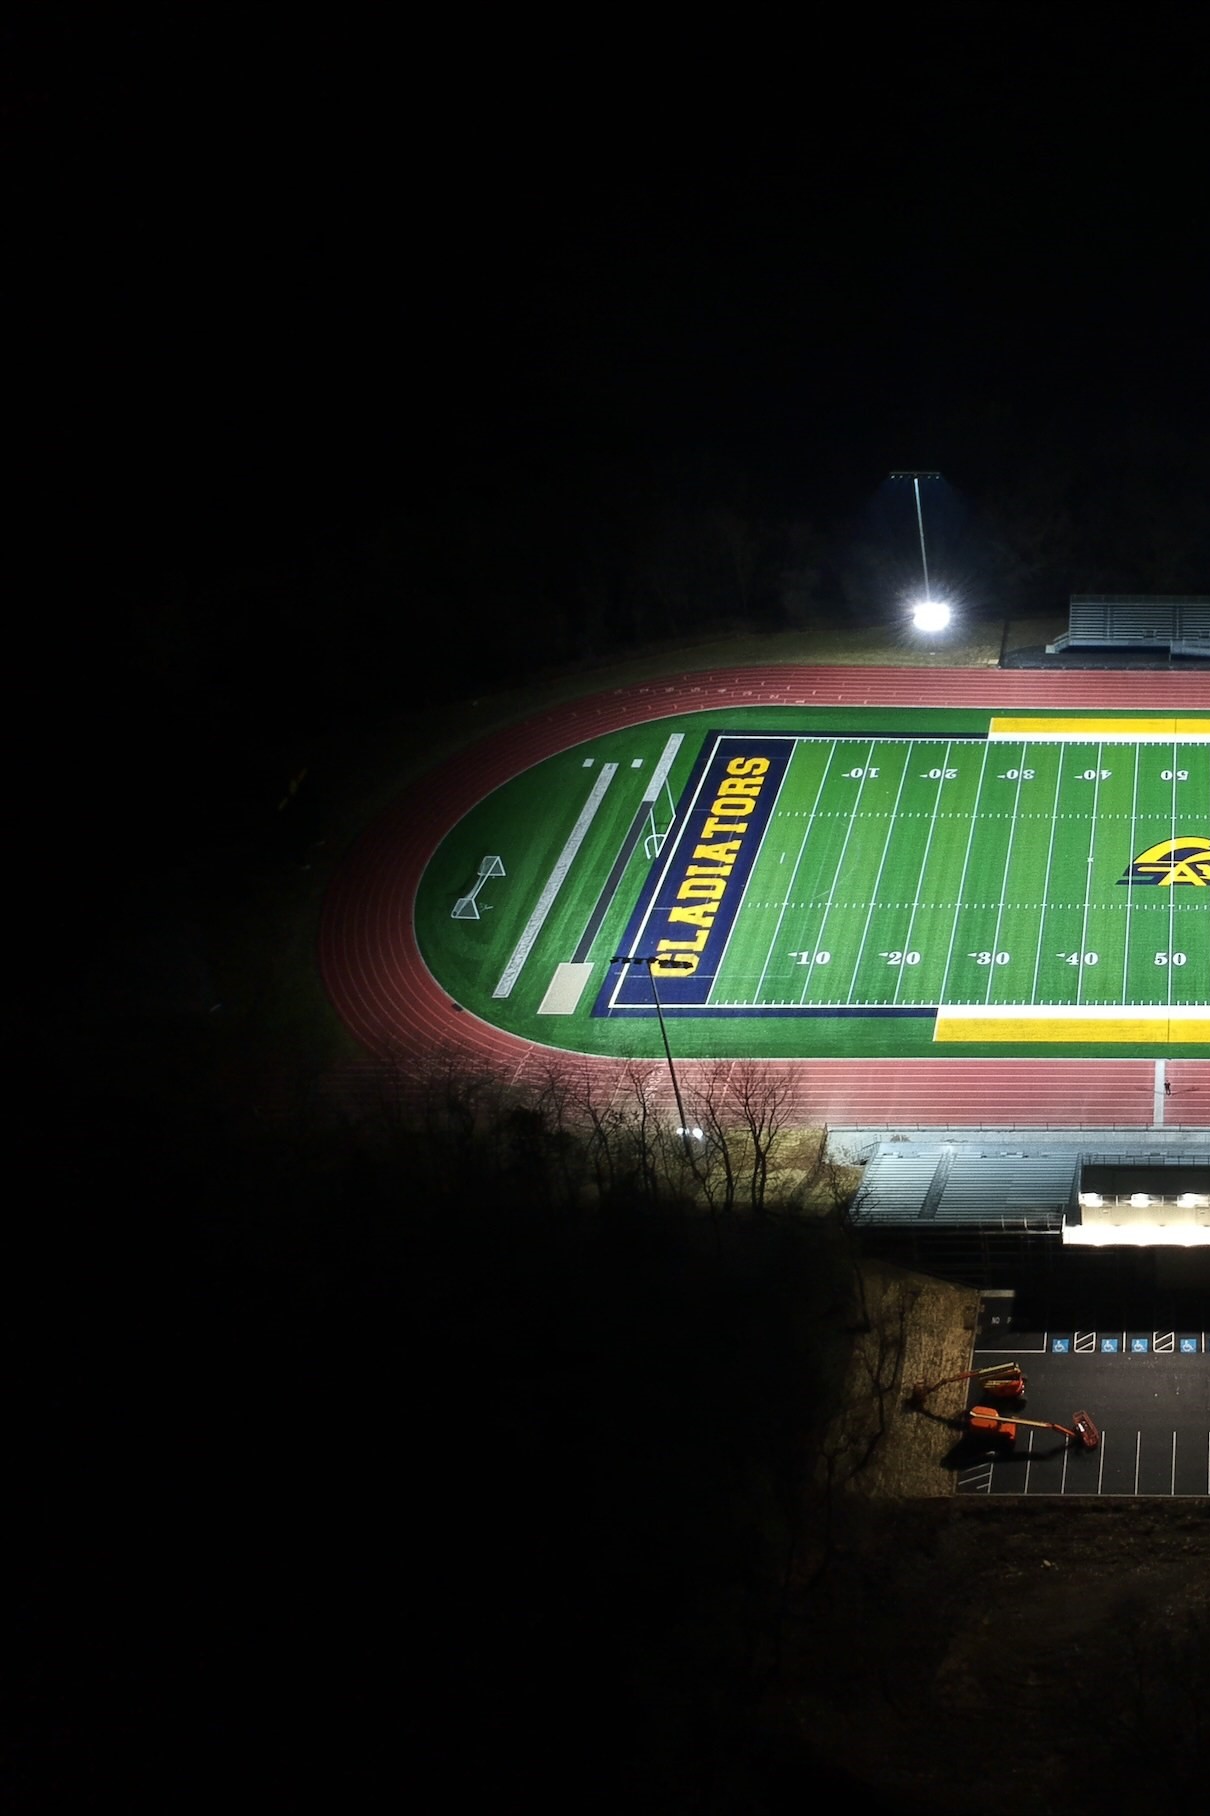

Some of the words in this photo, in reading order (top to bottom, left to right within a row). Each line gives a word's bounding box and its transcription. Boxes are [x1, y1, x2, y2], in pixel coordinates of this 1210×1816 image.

[796, 951, 831, 966] 10
[886, 951, 921, 966] 20
[976, 951, 1011, 966] 30
[1065, 951, 1099, 966] 40
[1153, 952, 1187, 966] 50
